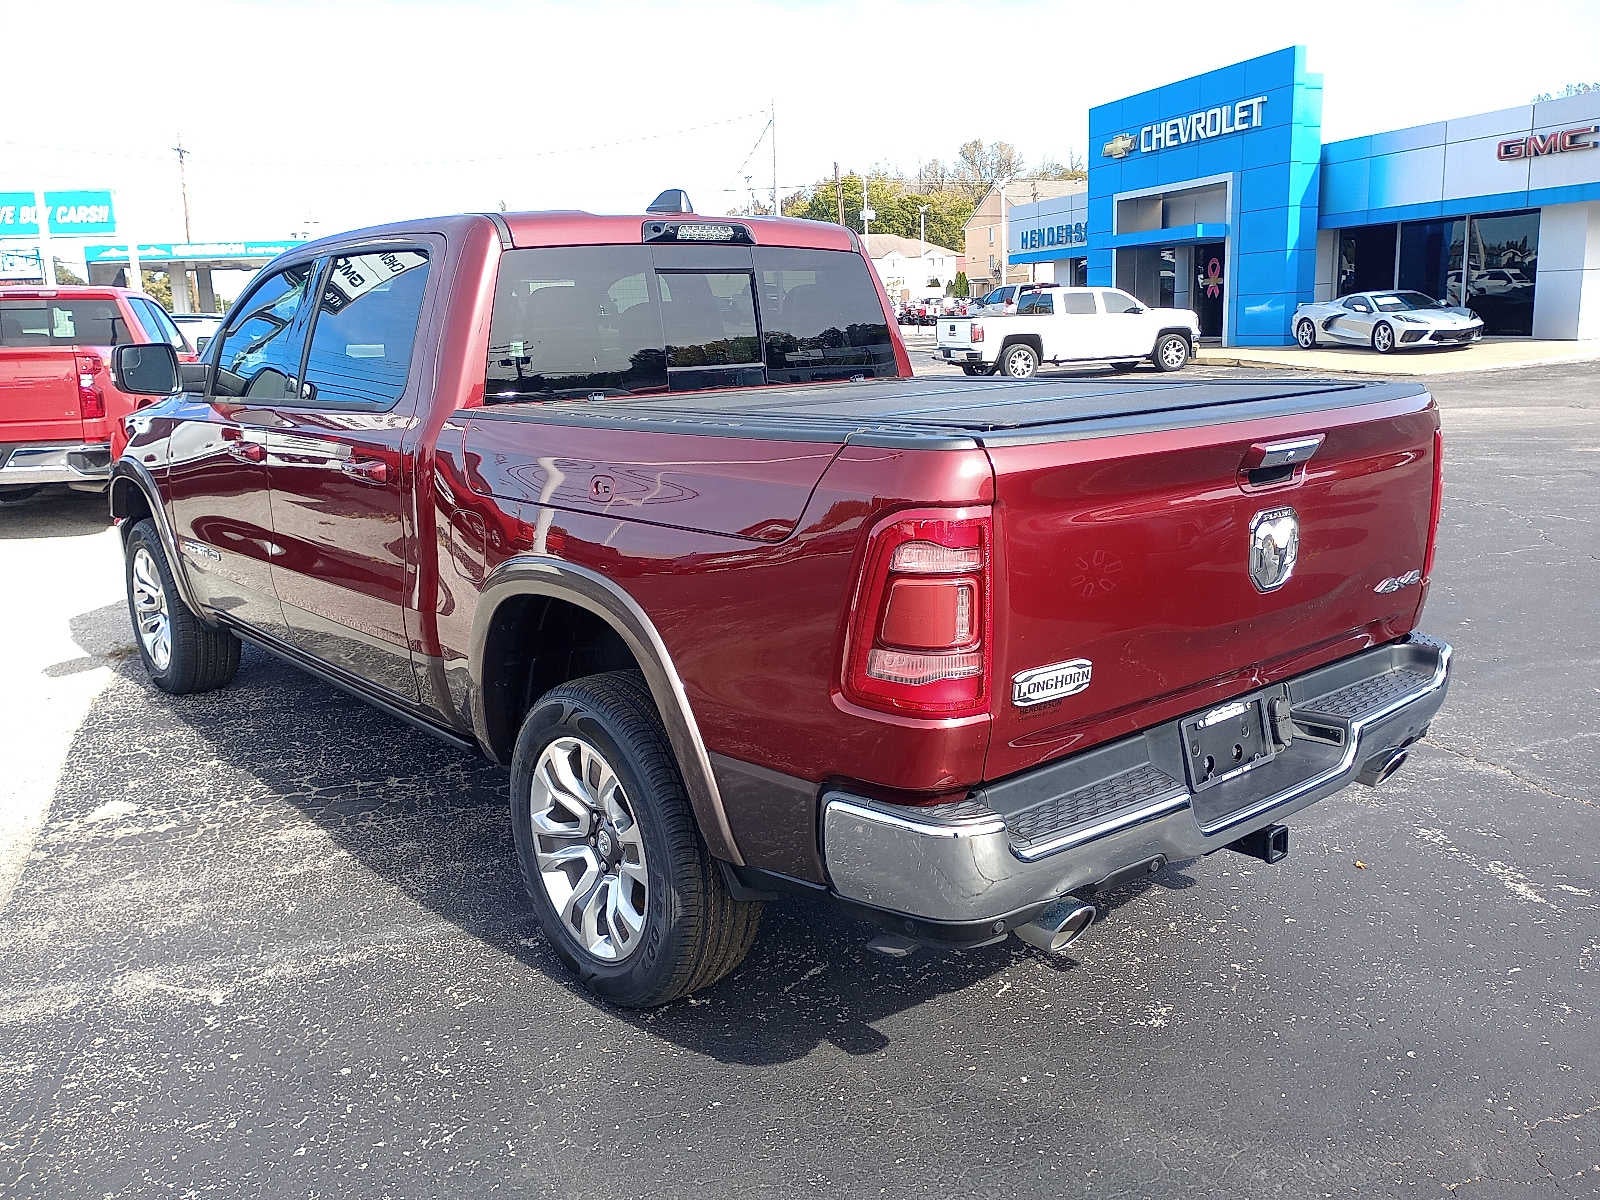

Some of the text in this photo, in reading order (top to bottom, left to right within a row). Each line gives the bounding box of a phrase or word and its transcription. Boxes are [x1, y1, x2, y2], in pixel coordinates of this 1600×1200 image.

[1140, 96, 1268, 153] CHEVROLET
[1497, 125, 1599, 161] GMC
[1016, 669, 1090, 699] LONGHORN
